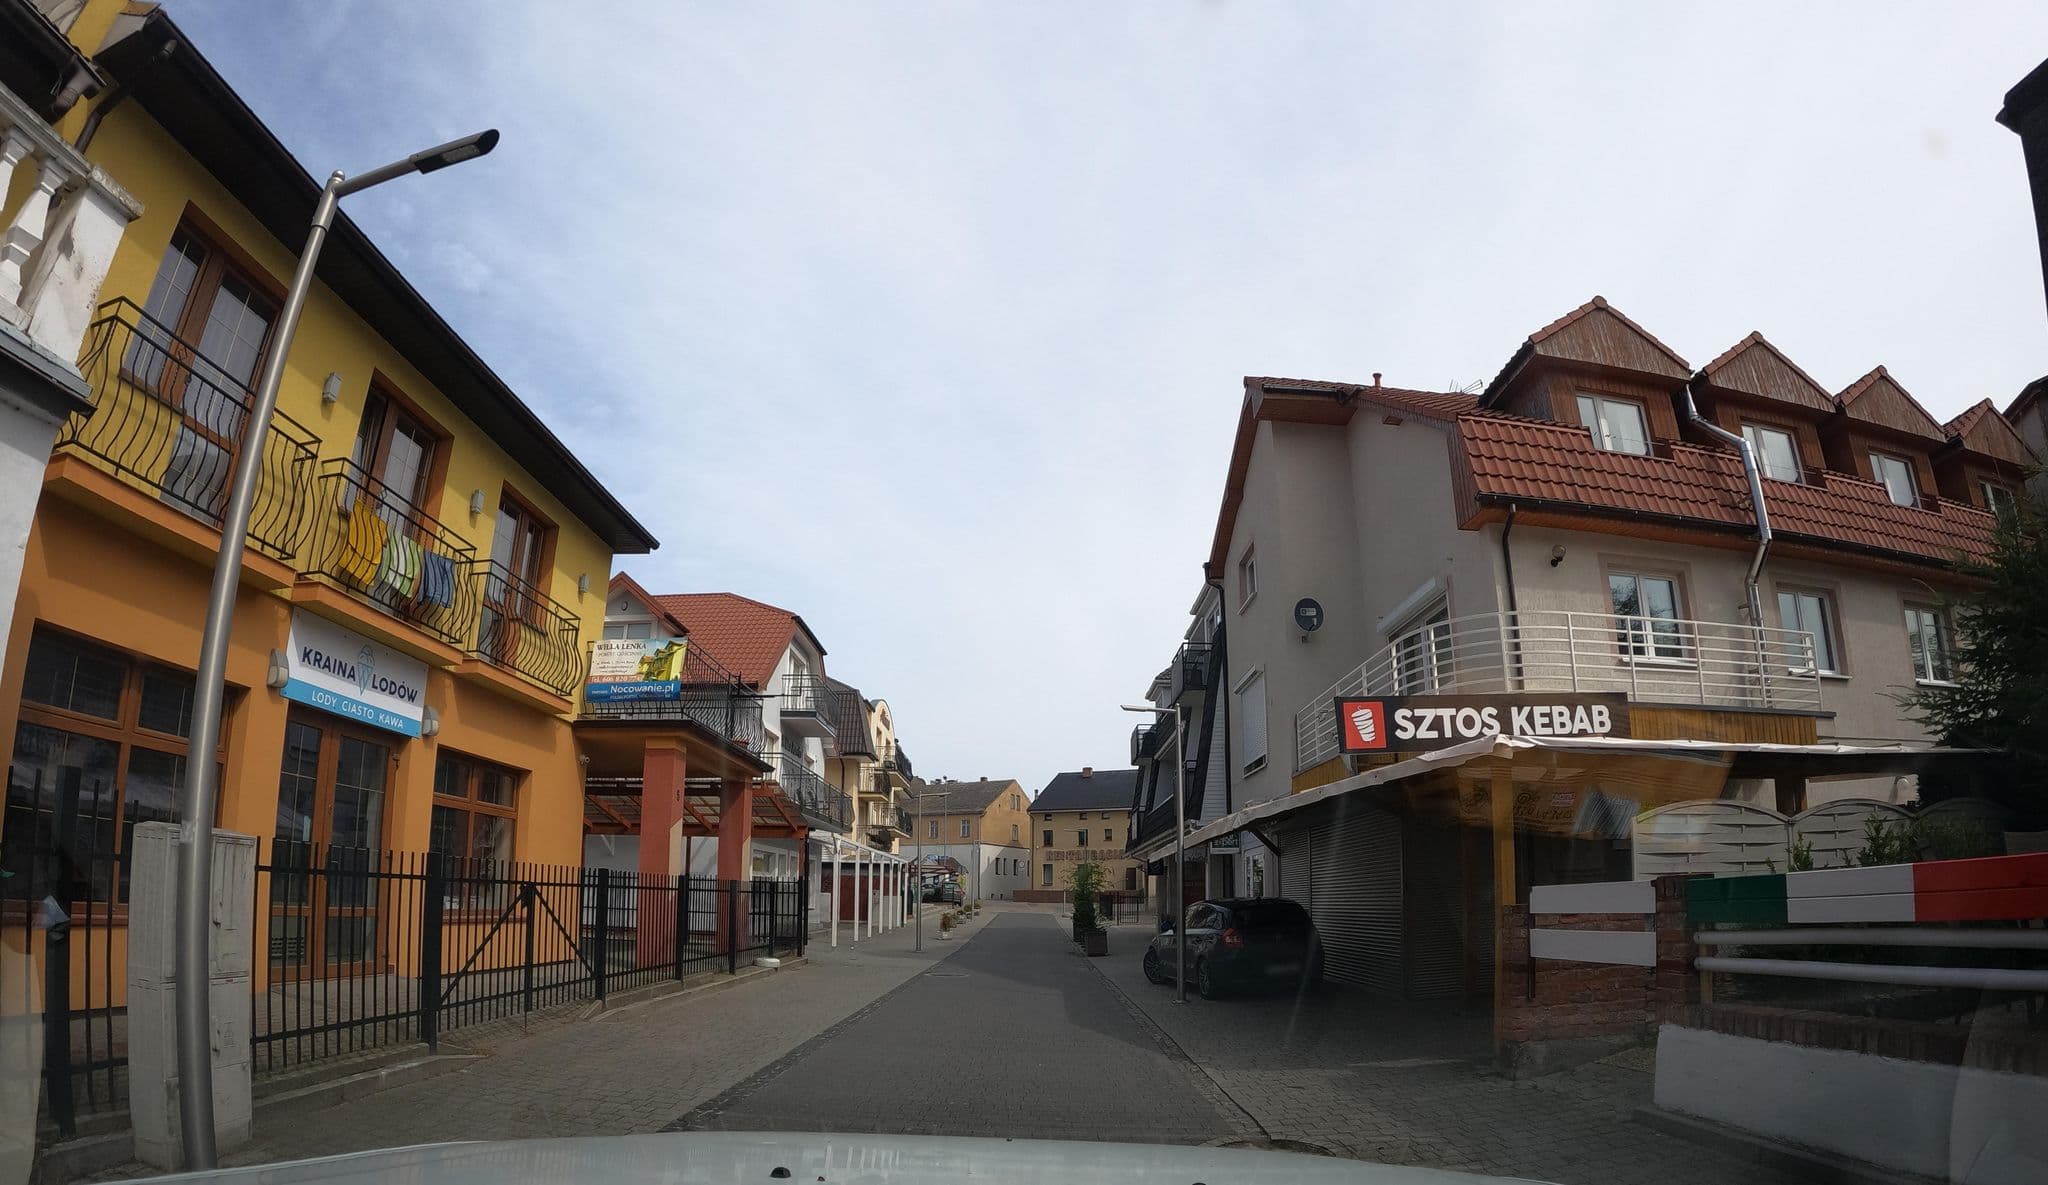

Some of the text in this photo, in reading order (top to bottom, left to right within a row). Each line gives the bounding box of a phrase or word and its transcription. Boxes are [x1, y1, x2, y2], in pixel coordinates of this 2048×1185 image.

[597, 643, 620, 651] WILLA
[302, 646, 418, 703] KRAINA LODÓW
[610, 683, 674, 694] Nocowanie.pl
[312, 691, 404, 729] LODY CIASTO KAWA
[1394, 705, 1611, 739] SZTOS KEBAB
